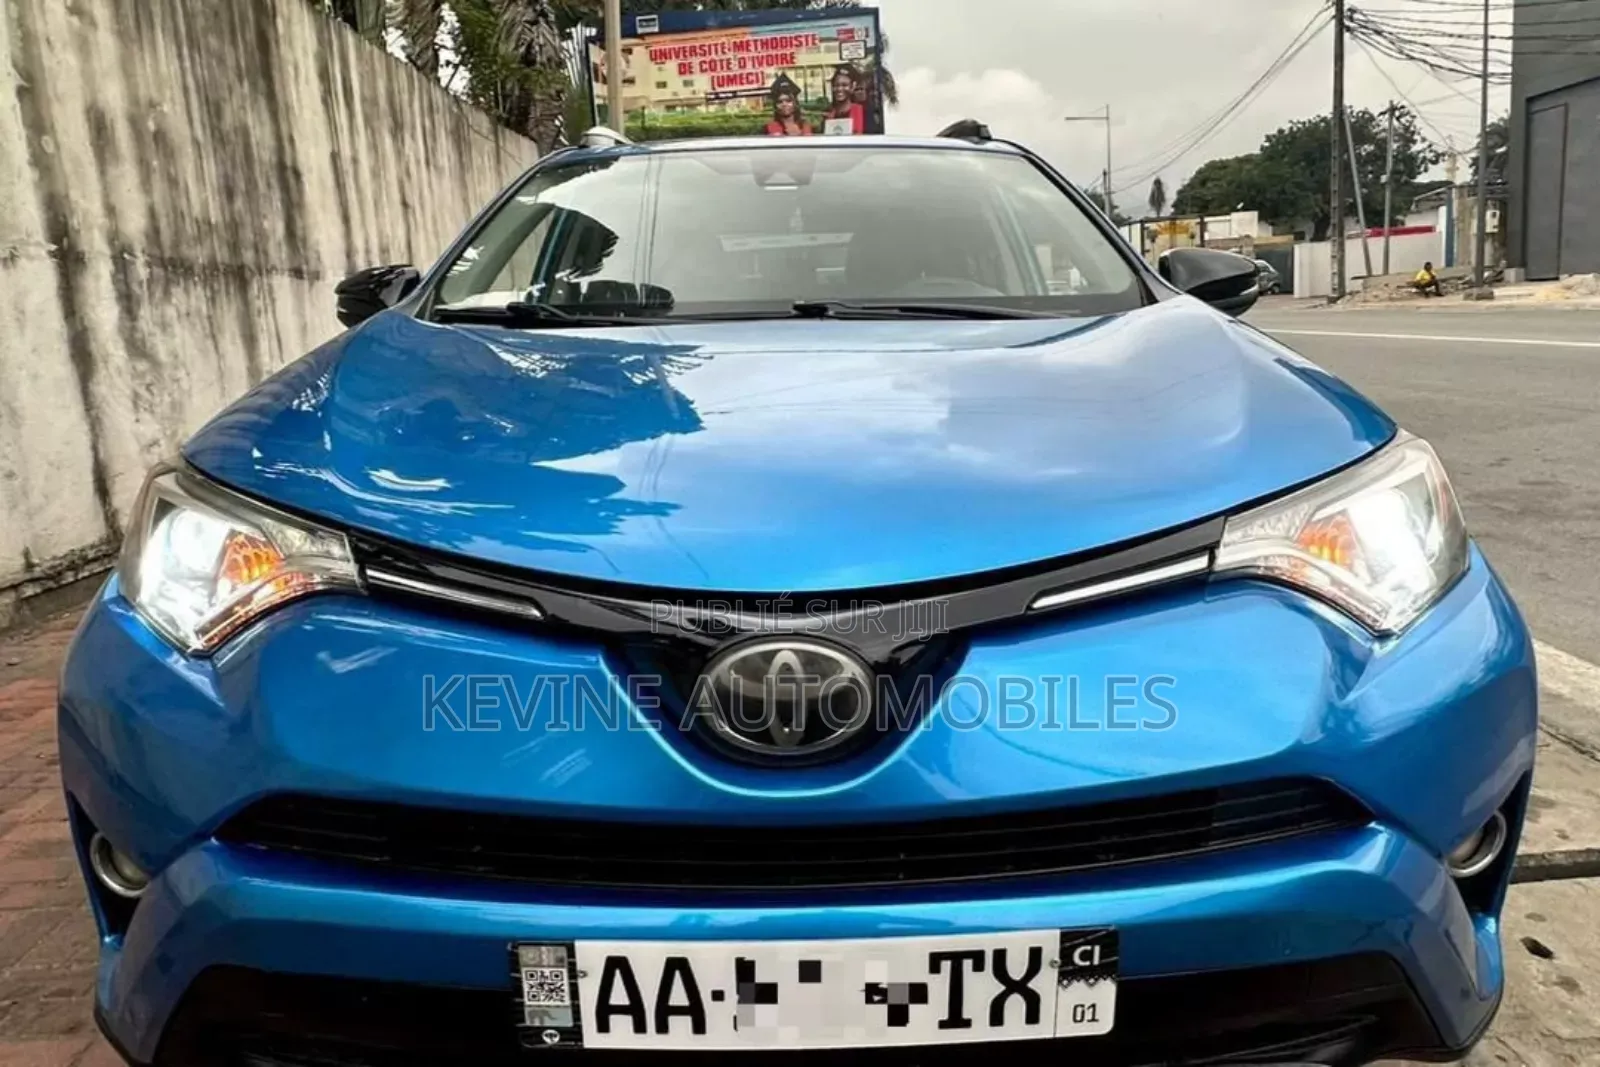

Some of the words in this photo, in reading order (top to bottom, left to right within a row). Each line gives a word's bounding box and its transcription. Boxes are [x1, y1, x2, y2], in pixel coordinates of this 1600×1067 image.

[677, 60, 695, 76] DE
[738, 51, 796, 70] D'IVOIRE
[1073, 945, 1101, 966] CI
[1072, 1003, 1100, 1024] 01
